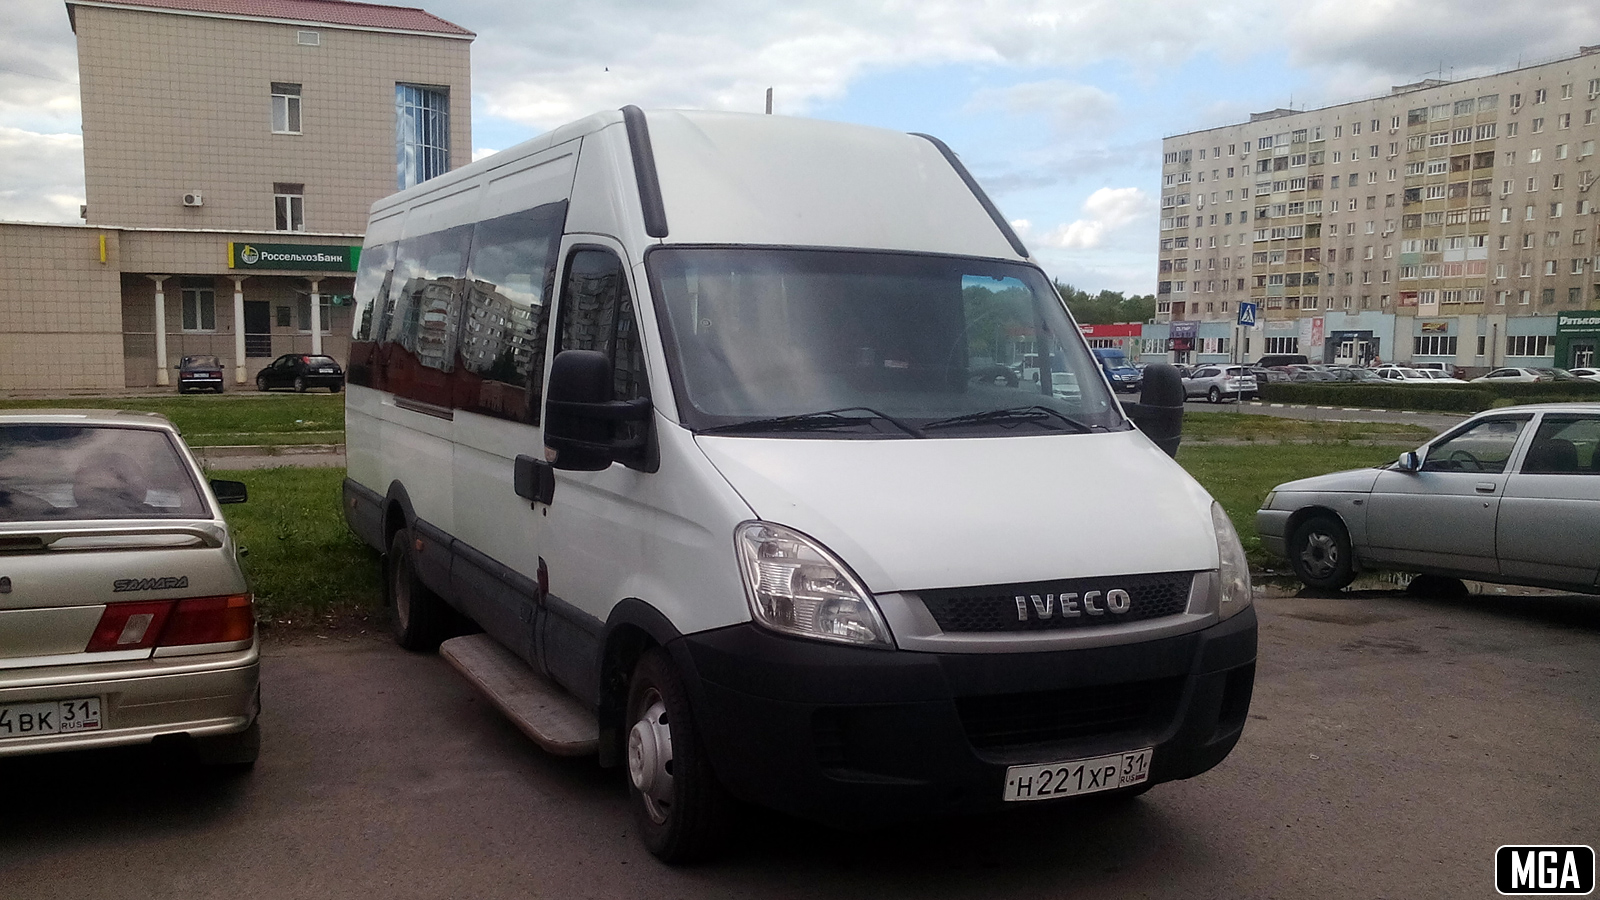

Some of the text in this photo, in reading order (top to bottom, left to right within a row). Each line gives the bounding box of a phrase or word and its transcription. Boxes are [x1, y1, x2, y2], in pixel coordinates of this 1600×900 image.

[261, 251, 343, 263] РоссельхозБанк
[113, 575, 189, 593] SAMARA
[1015, 588, 1131, 621] IVECO
[63, 701, 90, 721] 31
[61, 721, 83, 730] RUS
[1016, 752, 1145, 797] Н221ХР 31
[1120, 774, 1136, 783] RUS
